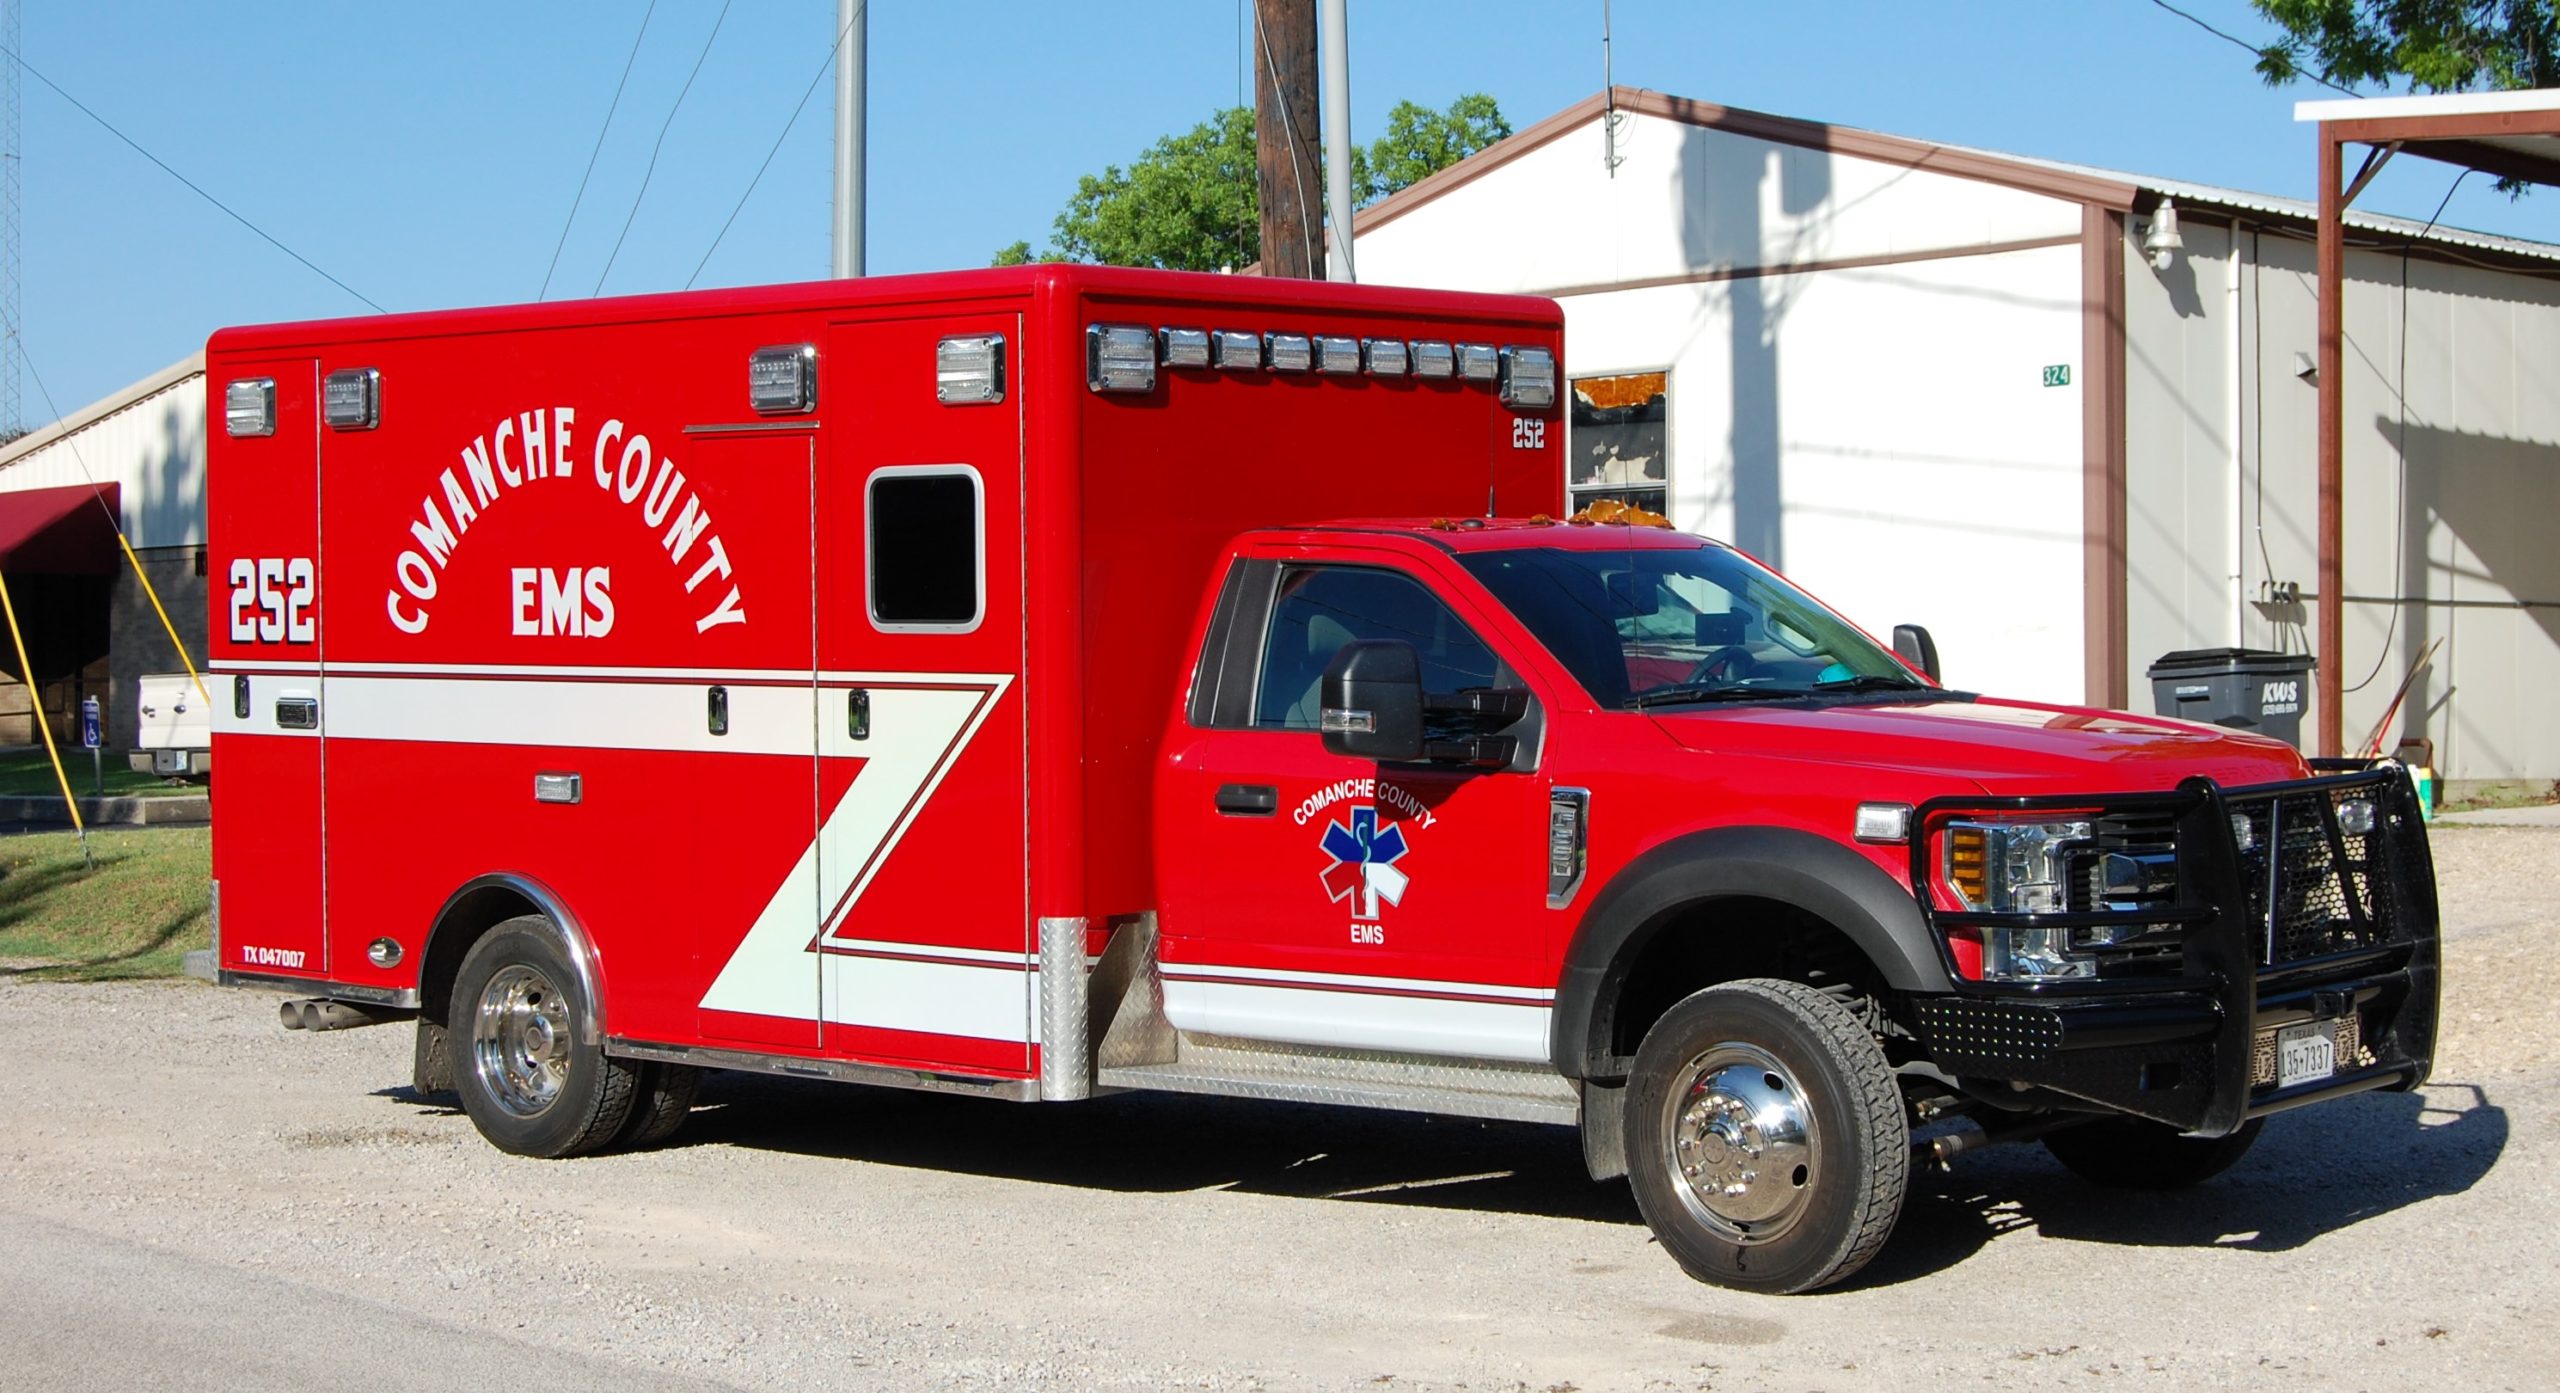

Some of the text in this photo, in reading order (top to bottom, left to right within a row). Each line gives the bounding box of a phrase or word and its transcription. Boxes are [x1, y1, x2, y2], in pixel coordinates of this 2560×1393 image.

[2044, 366, 2068, 385] 324
[1512, 417, 1545, 449] 252
[387, 407, 747, 635] COMANCHE COUNTY
[229, 557, 315, 642] 252
[511, 566, 615, 638] EMS
[2262, 681, 2298, 704] KWS
[1293, 778, 1437, 831] COMANCHE COUNTY
[1350, 923, 1385, 945] EMS
[243, 945, 306, 968] TX 047007
